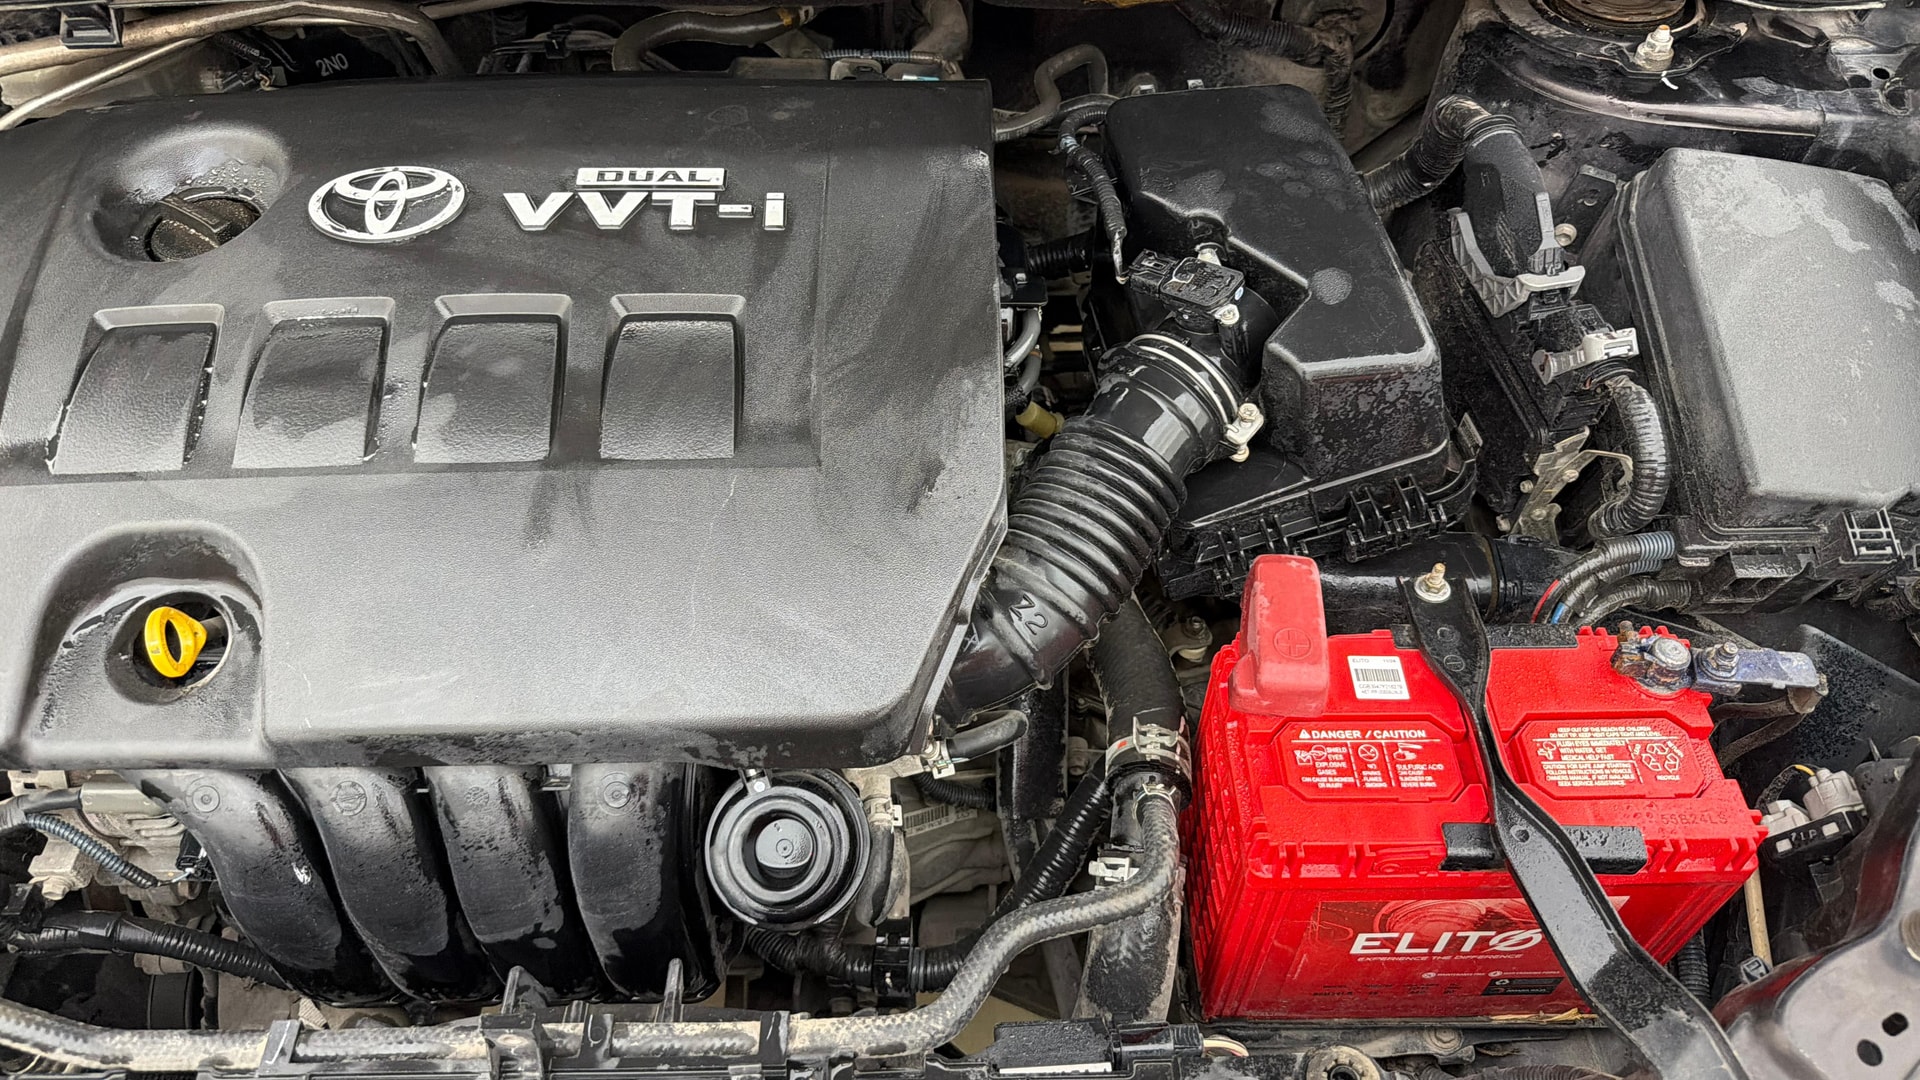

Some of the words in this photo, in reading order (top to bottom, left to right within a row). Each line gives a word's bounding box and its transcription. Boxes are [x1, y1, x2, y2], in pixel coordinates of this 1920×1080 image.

[596, 169, 715, 183] DUAL
[502, 191, 786, 231] VVT-i
[1311, 730, 1362, 739] DANGER
[1373, 730, 1427, 738] CAUTION
[1349, 928, 1543, 955] ELITO
